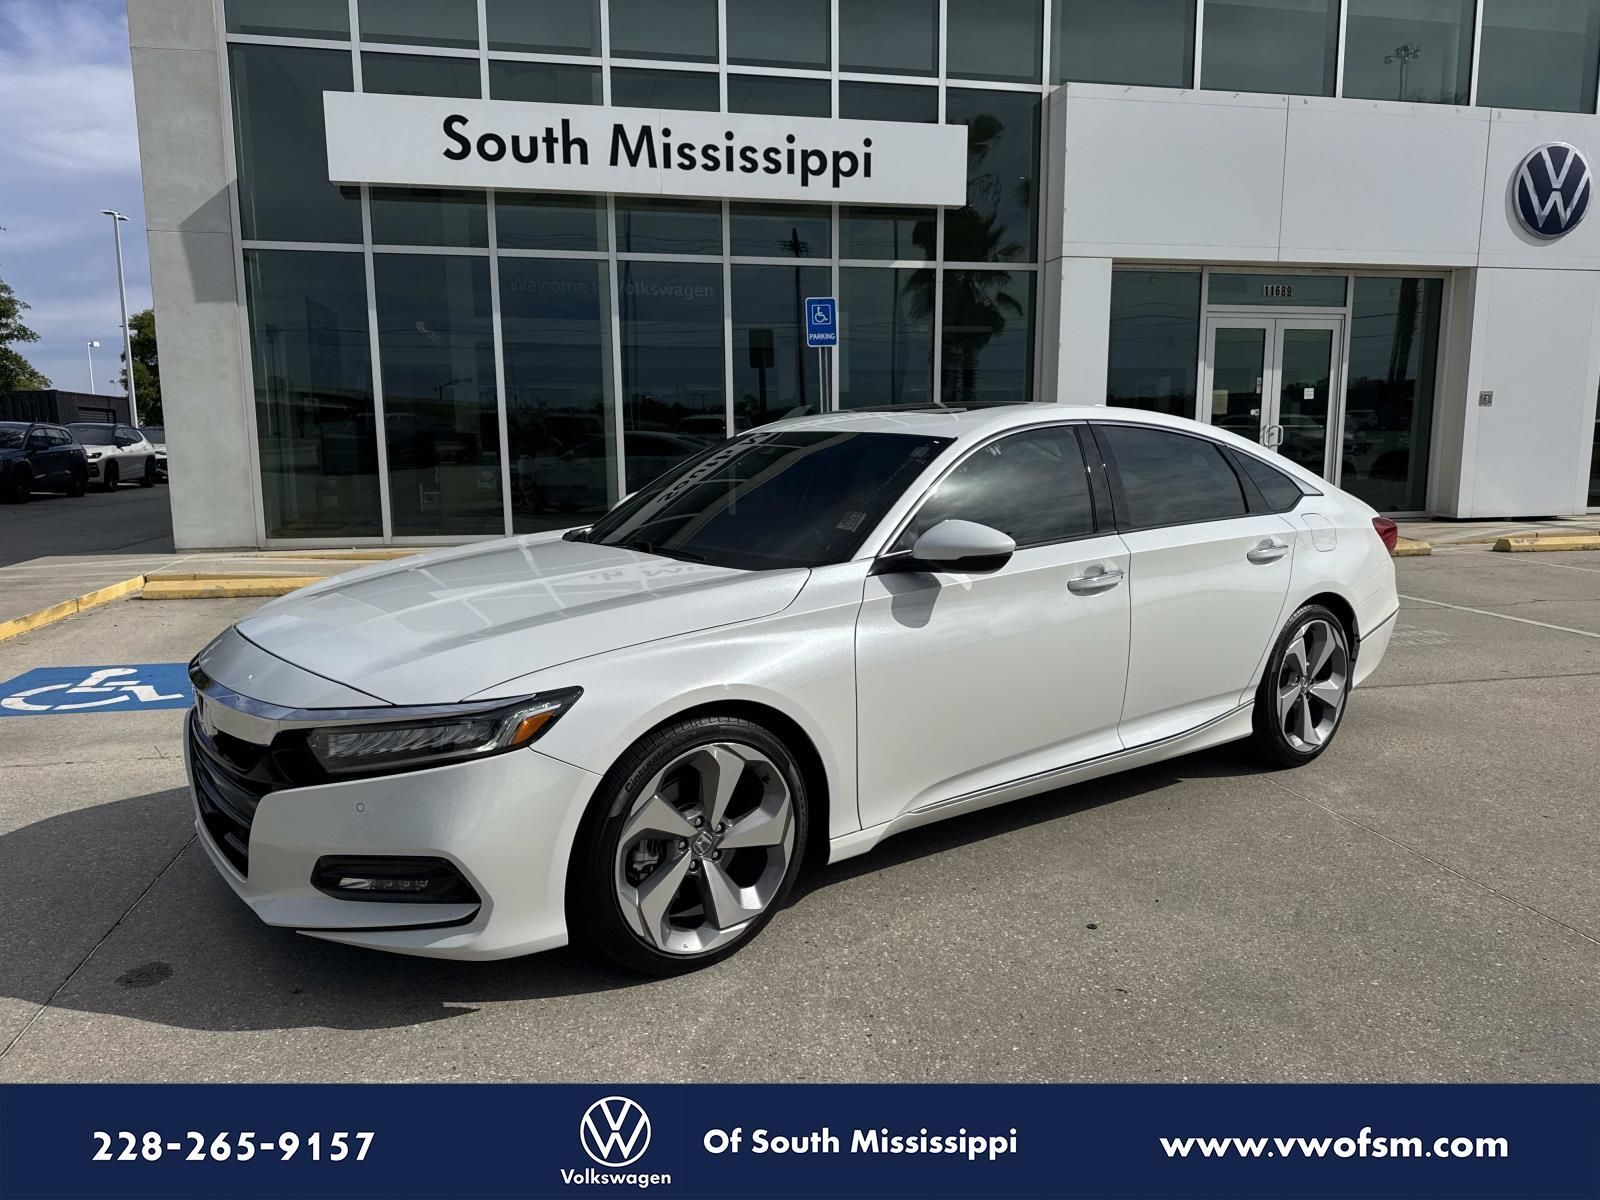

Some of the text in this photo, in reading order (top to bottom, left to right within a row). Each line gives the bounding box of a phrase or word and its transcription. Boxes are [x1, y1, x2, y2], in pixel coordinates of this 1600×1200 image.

[442, 114, 873, 189] South Mississippi
[511, 278, 587, 295] Welcome
[1264, 285, 1292, 297] 11689
[809, 332, 836, 341] PARKING
